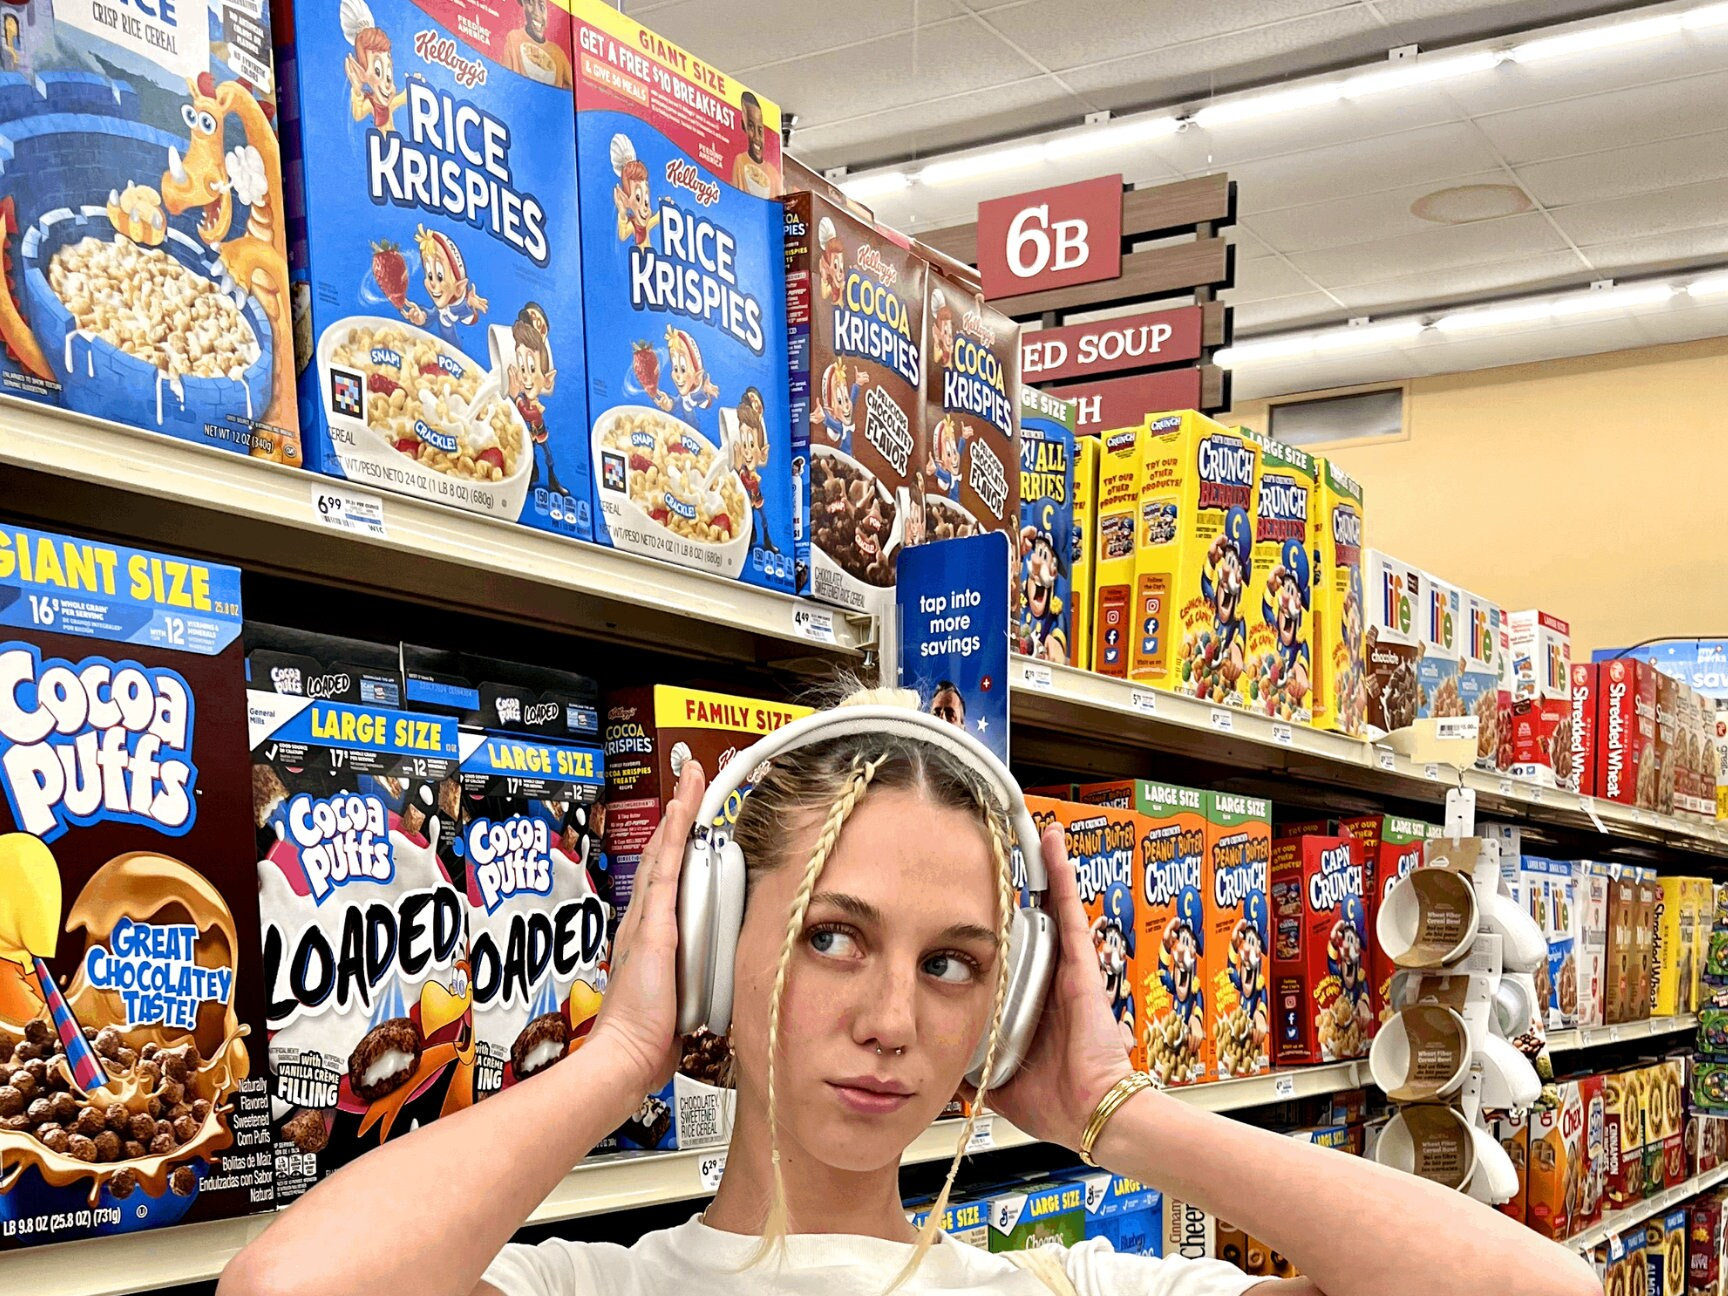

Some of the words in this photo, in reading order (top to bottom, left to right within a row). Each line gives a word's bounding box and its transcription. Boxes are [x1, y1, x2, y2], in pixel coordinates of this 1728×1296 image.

[92, 3, 118, 28] CRISP
[122, 17, 142, 40] RICE
[145, 31, 178, 55] CEREAL
[638, 29, 688, 72] GIANT
[692, 61, 727, 95] SIZE
[410, 84, 508, 182] RICE
[370, 135, 548, 261] KRISPIES
[662, 206, 735, 284] RICE
[1006, 203, 1090, 277] 6B
[631, 252, 762, 351] KRISPIES
[846, 273, 911, 342] COCOA
[372, 351, 400, 367] SNAP!
[835, 310, 920, 387] KRISPIES
[1023, 341, 1068, 373] ED
[1078, 324, 1173, 363] SOUP
[438, 358, 462, 378] POP!
[954, 338, 1006, 396] COCOA
[944, 371, 1012, 438] KRISPIES
[415, 422, 456, 450] CRACKLE!
[1250, 432, 1284, 460] LARGE
[1286, 447, 1308, 470] SIZE
[1035, 443, 1066, 473] ALL
[1199, 439, 1255, 487] CRUNCH
[664, 493, 696, 519] CRACKLE!
[1200, 480, 1251, 510] BERRIES
[1256, 517, 1306, 544] BERRIES
[0, 530, 118, 596] GIANT
[128, 555, 212, 612] SIZE
[921, 594, 947, 616] tap
[951, 589, 981, 610] into
[1383, 570, 1412, 636] life
[930, 616, 970, 634] more
[1431, 589, 1453, 650] life
[1471, 607, 1492, 664] life
[921, 635, 981, 657] savings
[0, 649, 187, 752] Cocoa
[309, 674, 349, 698] LOADED
[249, 708, 276, 718] General
[524, 703, 559, 725] LOADED
[685, 699, 750, 728] FAMILY
[312, 708, 386, 745] LARGE
[395, 718, 442, 751] SIZE
[606, 723, 645, 740] COCOA
[488, 743, 551, 774] LARGE
[557, 749, 594, 778] SIZE
[622, 766, 651, 776] KRISPIES
[613, 776, 636, 785] TREATS
[1144, 784, 1178, 806] LARGE
[1181, 790, 1201, 808] SIZE
[289, 796, 384, 848] Cocoa
[1215, 794, 1246, 815] LARGE
[1247, 799, 1267, 818] SIZE
[469, 819, 548, 865] Cocoa
[1143, 836, 1176, 863] PEANUT
[1178, 832, 1204, 857] BUTTER
[1321, 845, 1350, 877] CAP'N
[1309, 865, 1364, 911] CRUNCH
[112, 916, 197, 961] GREAT
[263, 886, 462, 1022] LOADED
[87, 948, 232, 1000] CHOCOLATEY
[122, 991, 197, 1029] TASTE!
[301, 1053, 322, 1068] with
[278, 1076, 338, 1109] FILLING
[233, 1112, 269, 1129] Sweetened
[680, 1110, 716, 1125] SWEETENED
[680, 1124, 695, 1139] RICE
[696, 1121, 718, 1135] CEREAL
[1562, 1107, 1582, 1139] Chex
[250, 1186, 274, 1203] Natural
[1030, 1195, 1061, 1217] LARGE
[1062, 1189, 1081, 1209] SIZE
[1114, 1178, 1141, 1196] LARGE
[3, 1219, 17, 1237] LB
[18, 1216, 34, 1234] 9.8
[35, 1213, 48, 1232] OZ
[50, 1211, 74, 1233] (25.8
[75, 1210, 91, 1228] OZ)
[93, 1206, 121, 1228] (731g)
[957, 1206, 979, 1228] SIZE
